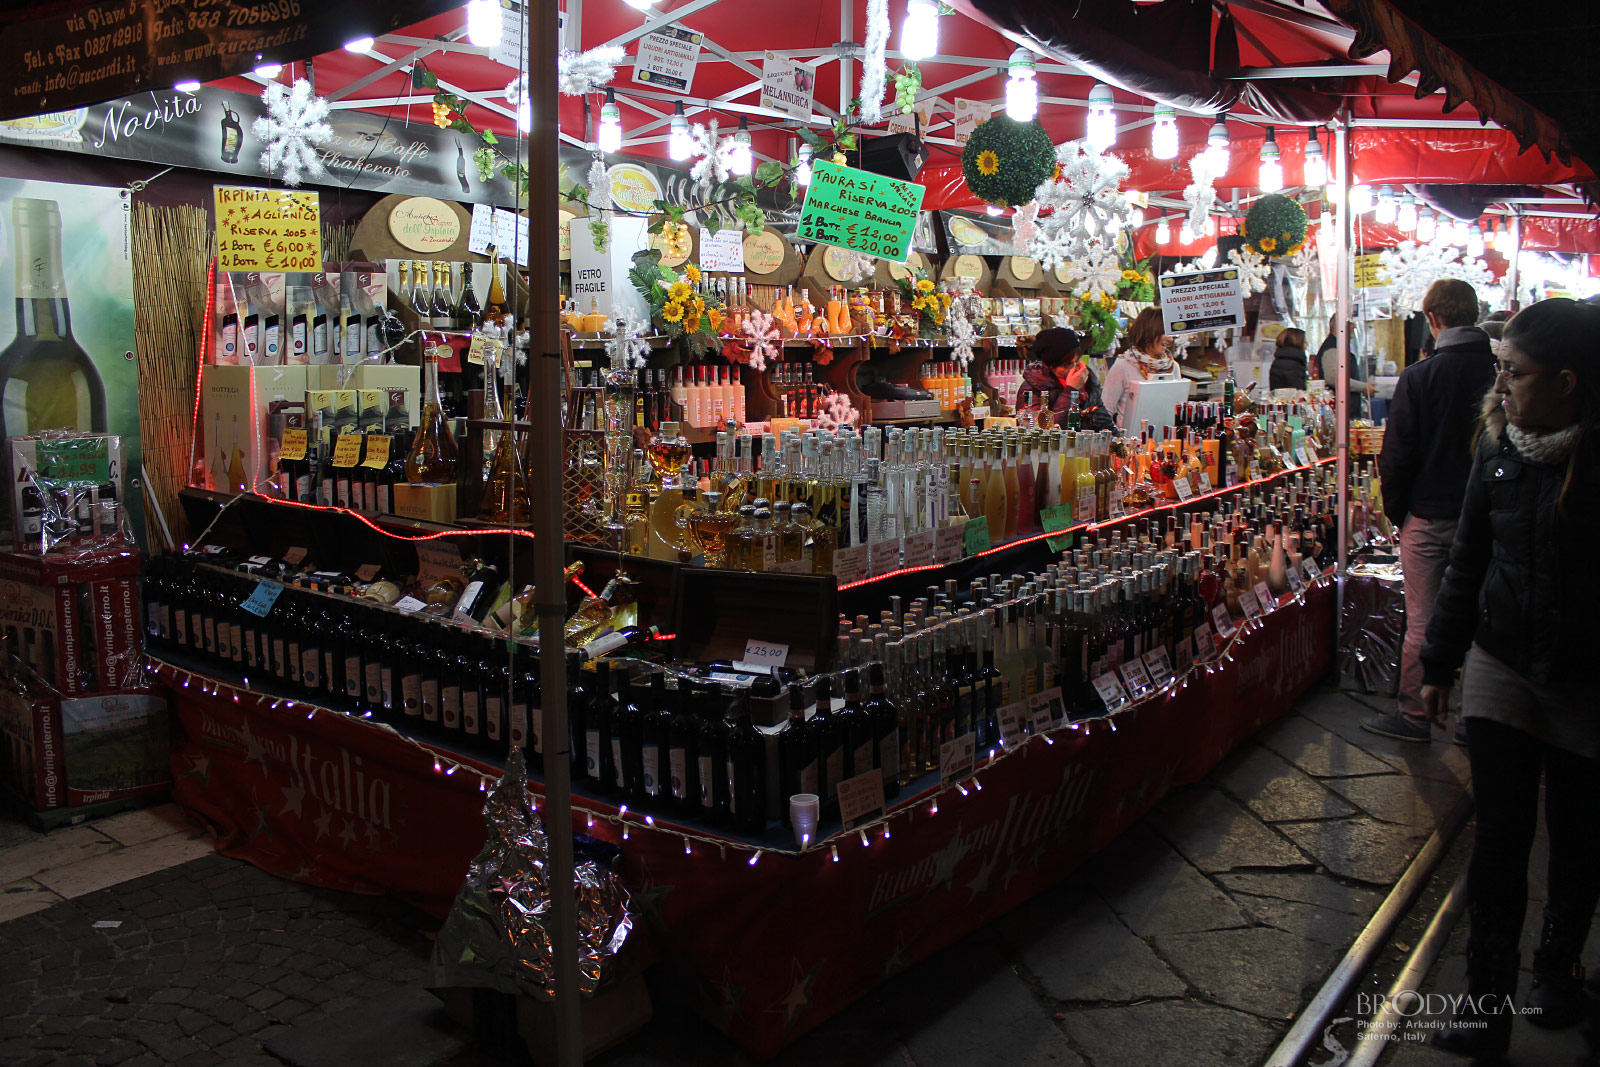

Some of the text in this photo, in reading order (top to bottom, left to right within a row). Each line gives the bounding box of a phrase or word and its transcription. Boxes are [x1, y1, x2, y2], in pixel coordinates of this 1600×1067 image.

[66, 13, 87, 33] via
[153, 16, 186, 42] Info:
[187, 10, 222, 32] 338
[226, 0, 302, 27] 7056996
[157, 24, 309, 67] web: www.zuccardi.it
[650, 35, 693, 52] PREZZO SPECIALE
[24, 49, 46, 73] Tel.
[48, 51, 56, 65] e
[55, 43, 81, 67] Fax
[643, 43, 695, 62] LIQUORI ARTIGIANALI
[14, 54, 136, 97] e-mail: info@zuccardi.it
[767, 71, 793, 79] LIQUORE
[762, 84, 809, 109] MELANNURCA
[95, 91, 202, 148] Novità
[348, 134, 367, 148] di
[378, 135, 430, 162] Caffè
[316, 150, 412, 177] Shakerato
[808, 197, 861, 217] MARCHESE
[888, 204, 918, 219] 2005
[802, 214, 813, 226] 1
[283, 228, 307, 239] 2005
[803, 226, 814, 238] 2
[219, 240, 228, 251] 1
[221, 255, 229, 267] 2
[577, 268, 602, 280] VETRO
[575, 282, 606, 294] FRAGILE
[1171, 283, 1230, 295] PREZZO SPECIALE
[1166, 290, 1236, 304] LIQUORI ARTIGIANALI
[1184, 303, 1199, 311] BOT.
[1202, 300, 1219, 308] 12,00
[1186, 311, 1201, 319] BOT.
[1203, 309, 1221, 317] 20,00
[211, 386, 240, 394] BOTTEGA
[62, 589, 77, 693] info@vinipaterno.it
[40, 705, 58, 807] info@vinipaterno.it
